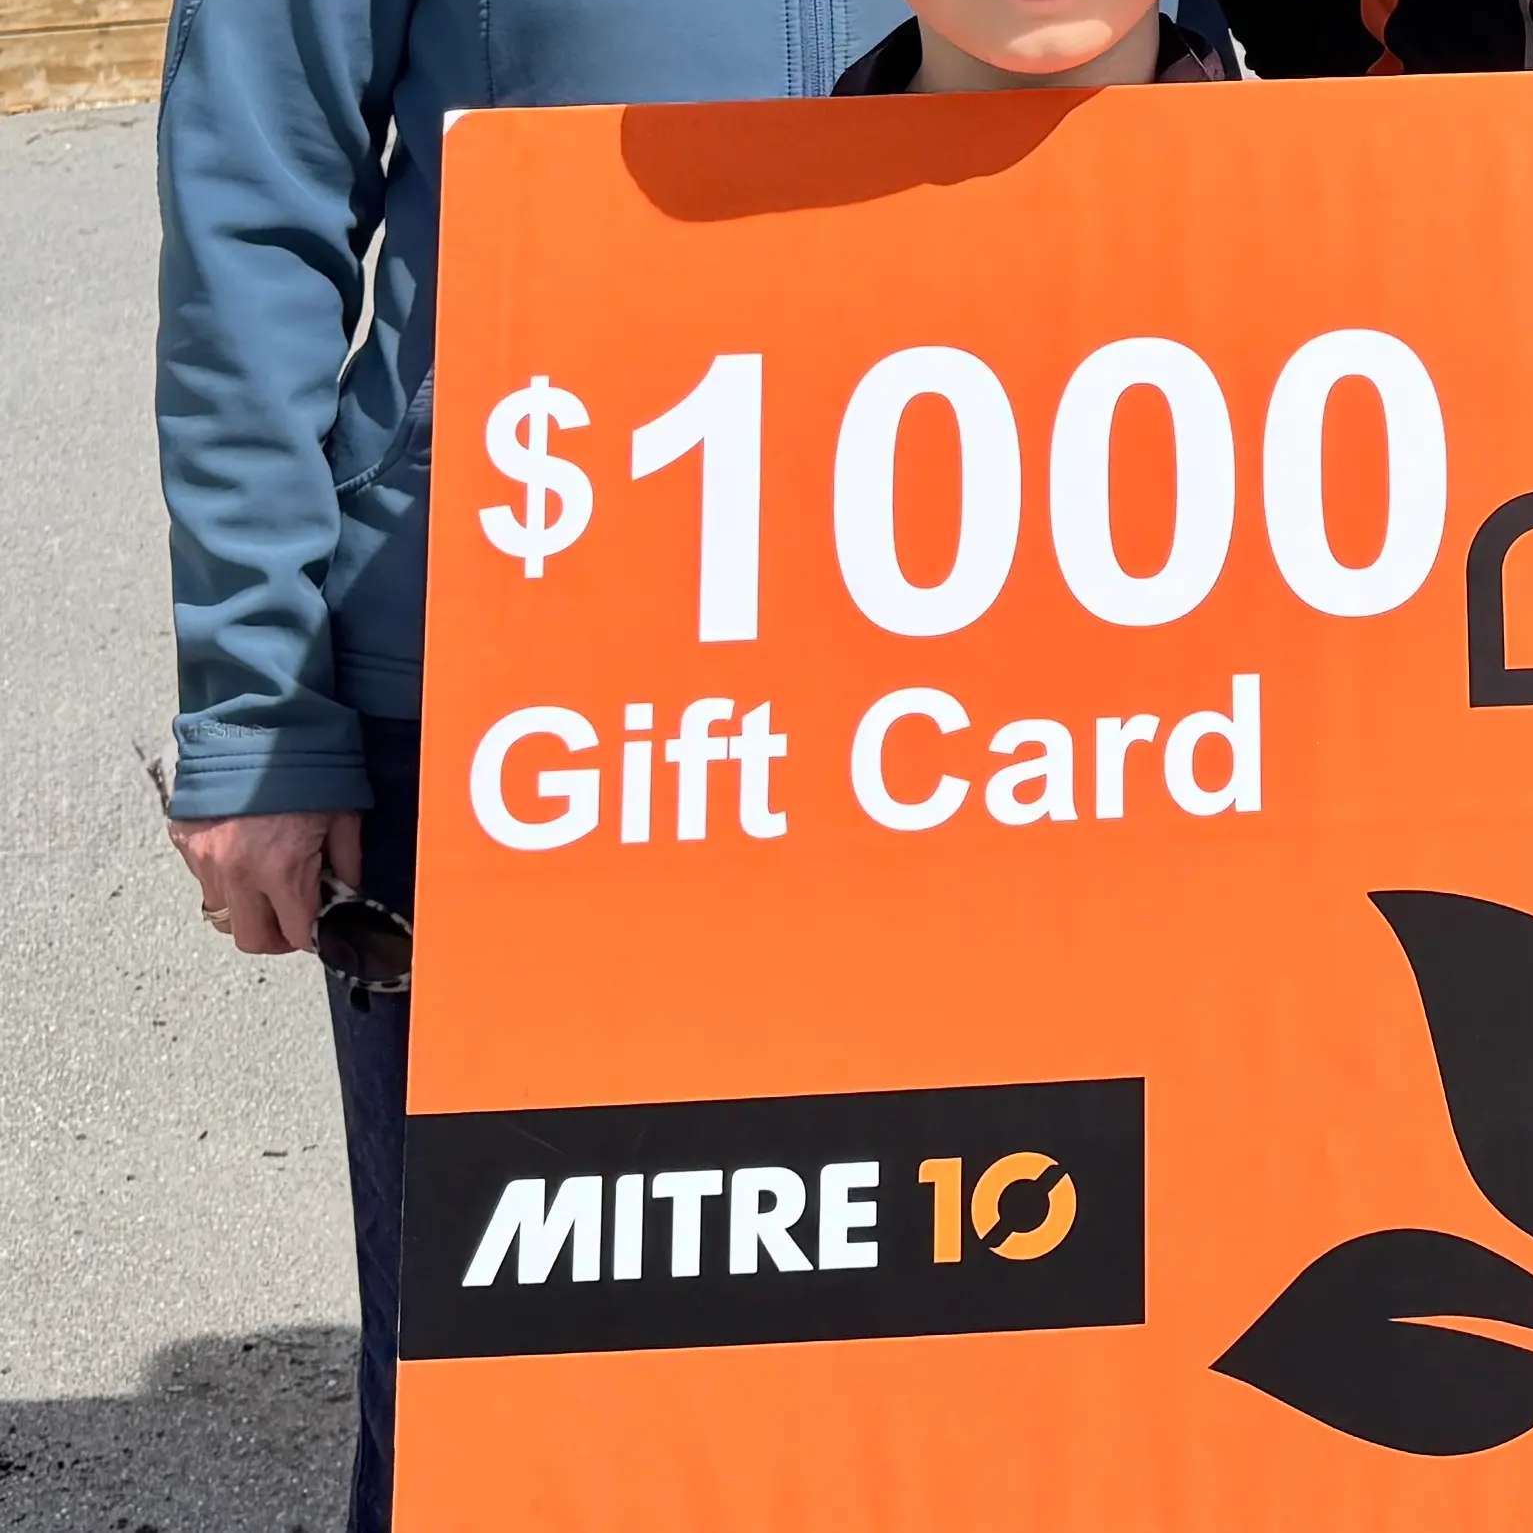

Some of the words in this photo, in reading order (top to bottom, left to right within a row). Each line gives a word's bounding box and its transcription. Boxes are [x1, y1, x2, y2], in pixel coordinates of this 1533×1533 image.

[479, 328, 1448, 642] $1000
[469, 697, 788, 851] Gift
[850, 673, 1263, 832] Card
[462, 1160, 880, 1287] MITRE
[918, 1151, 1077, 1261] 10
